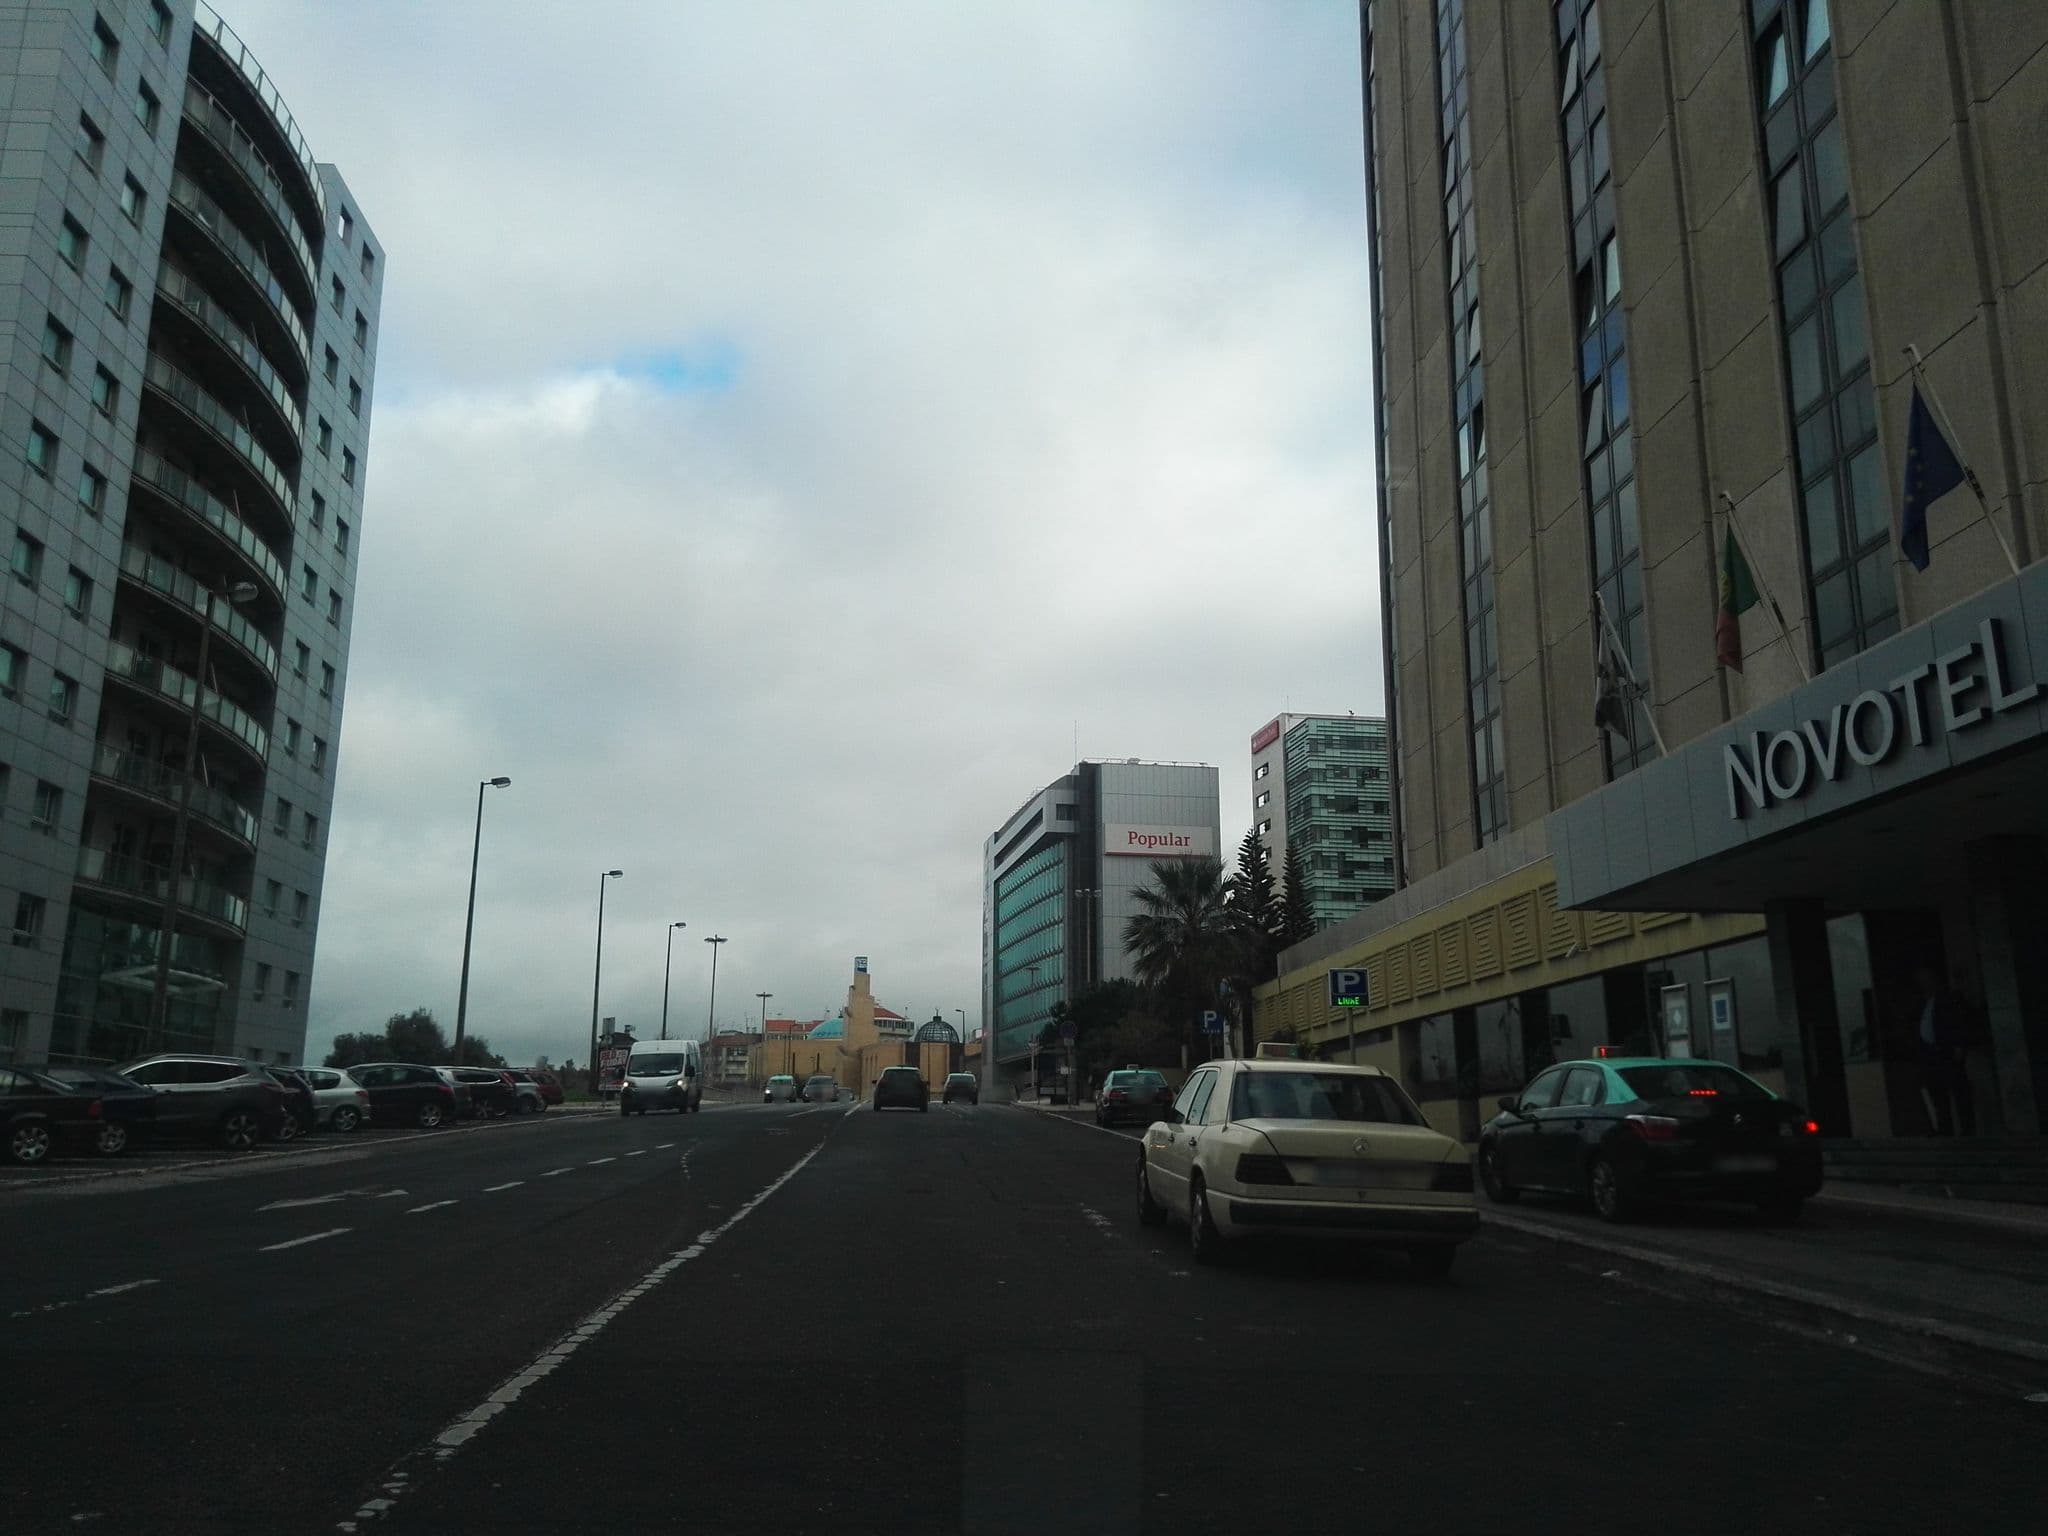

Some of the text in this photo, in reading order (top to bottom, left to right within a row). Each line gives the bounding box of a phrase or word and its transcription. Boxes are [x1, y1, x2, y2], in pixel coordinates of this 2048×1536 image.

[1723, 618, 2043, 820] NOVOTEL
[1127, 831, 1190, 849] Popular
[1337, 972, 1361, 994] P
[1203, 1010, 1218, 1029] P
